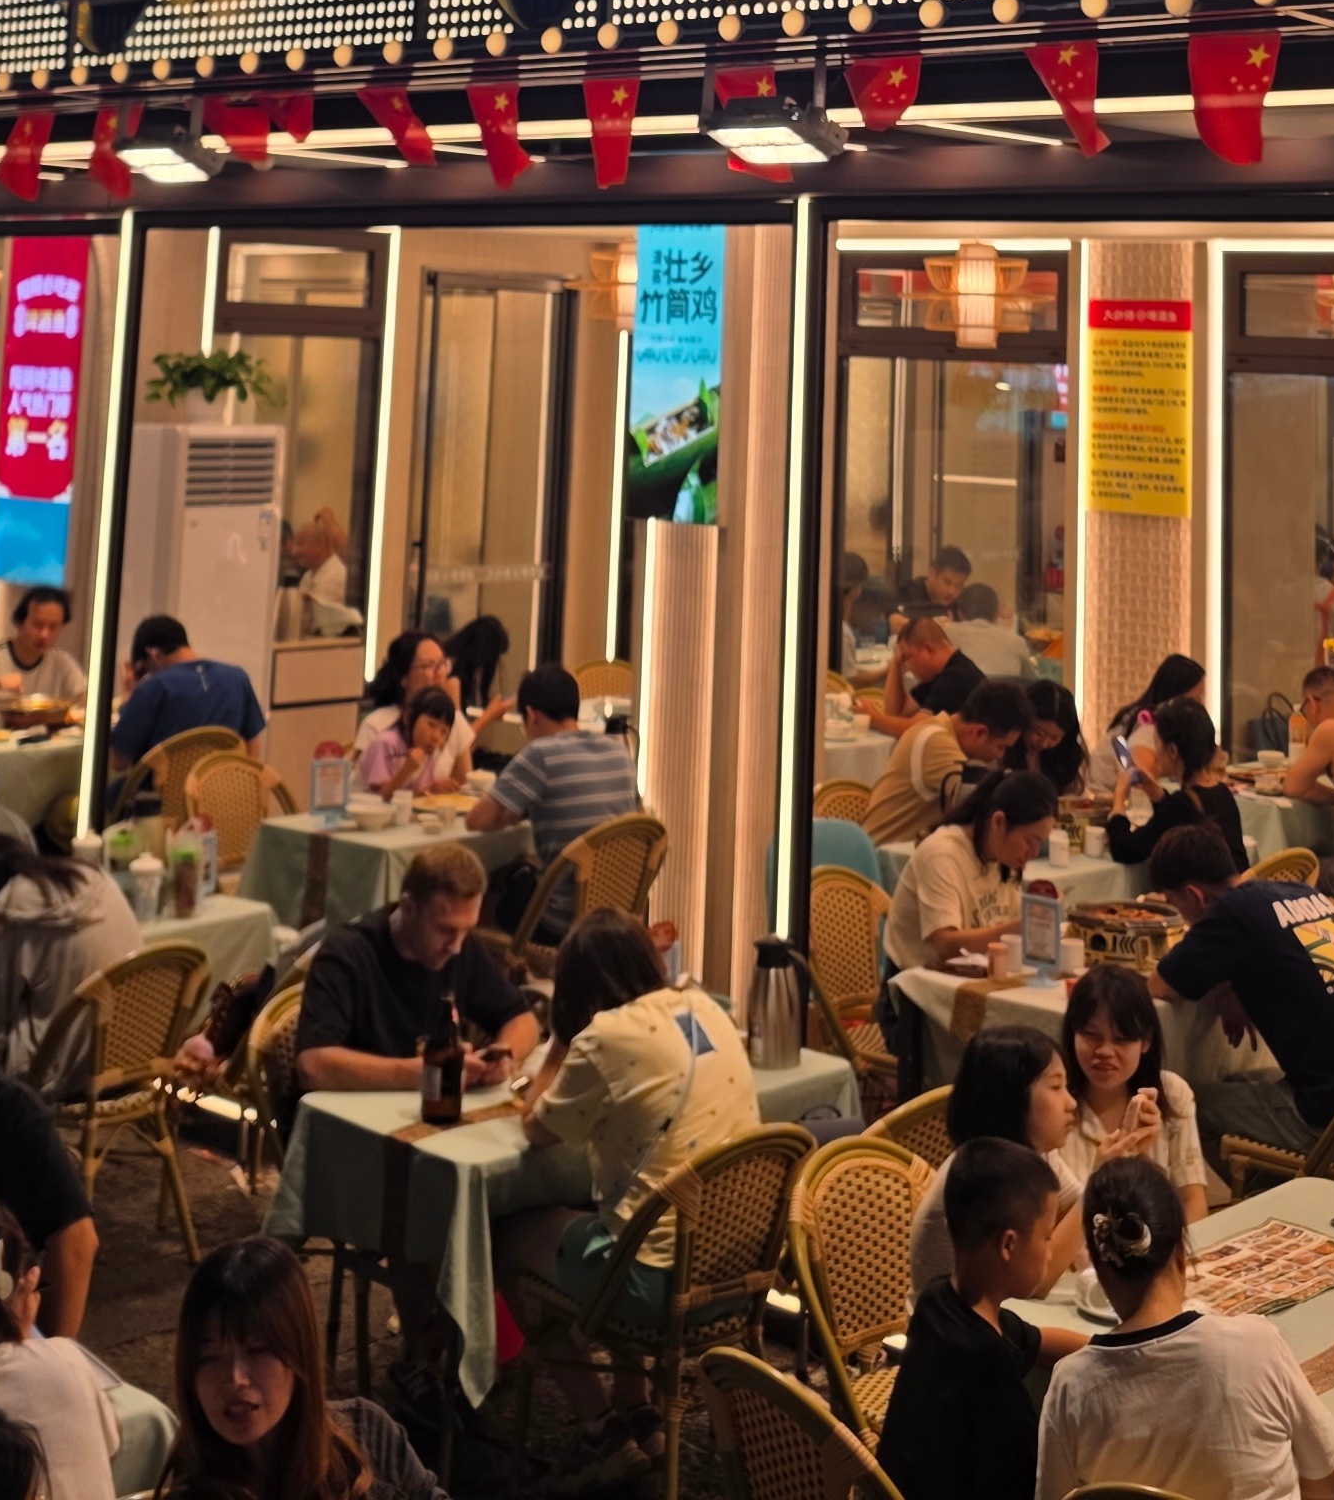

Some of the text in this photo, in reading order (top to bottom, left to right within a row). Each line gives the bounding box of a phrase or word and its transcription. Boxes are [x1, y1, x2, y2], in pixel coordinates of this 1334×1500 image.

[664, 248, 713, 285] 壮乡
[639, 285, 717, 325] 竹筒鸡
[5, 416, 69, 460] 第一名
